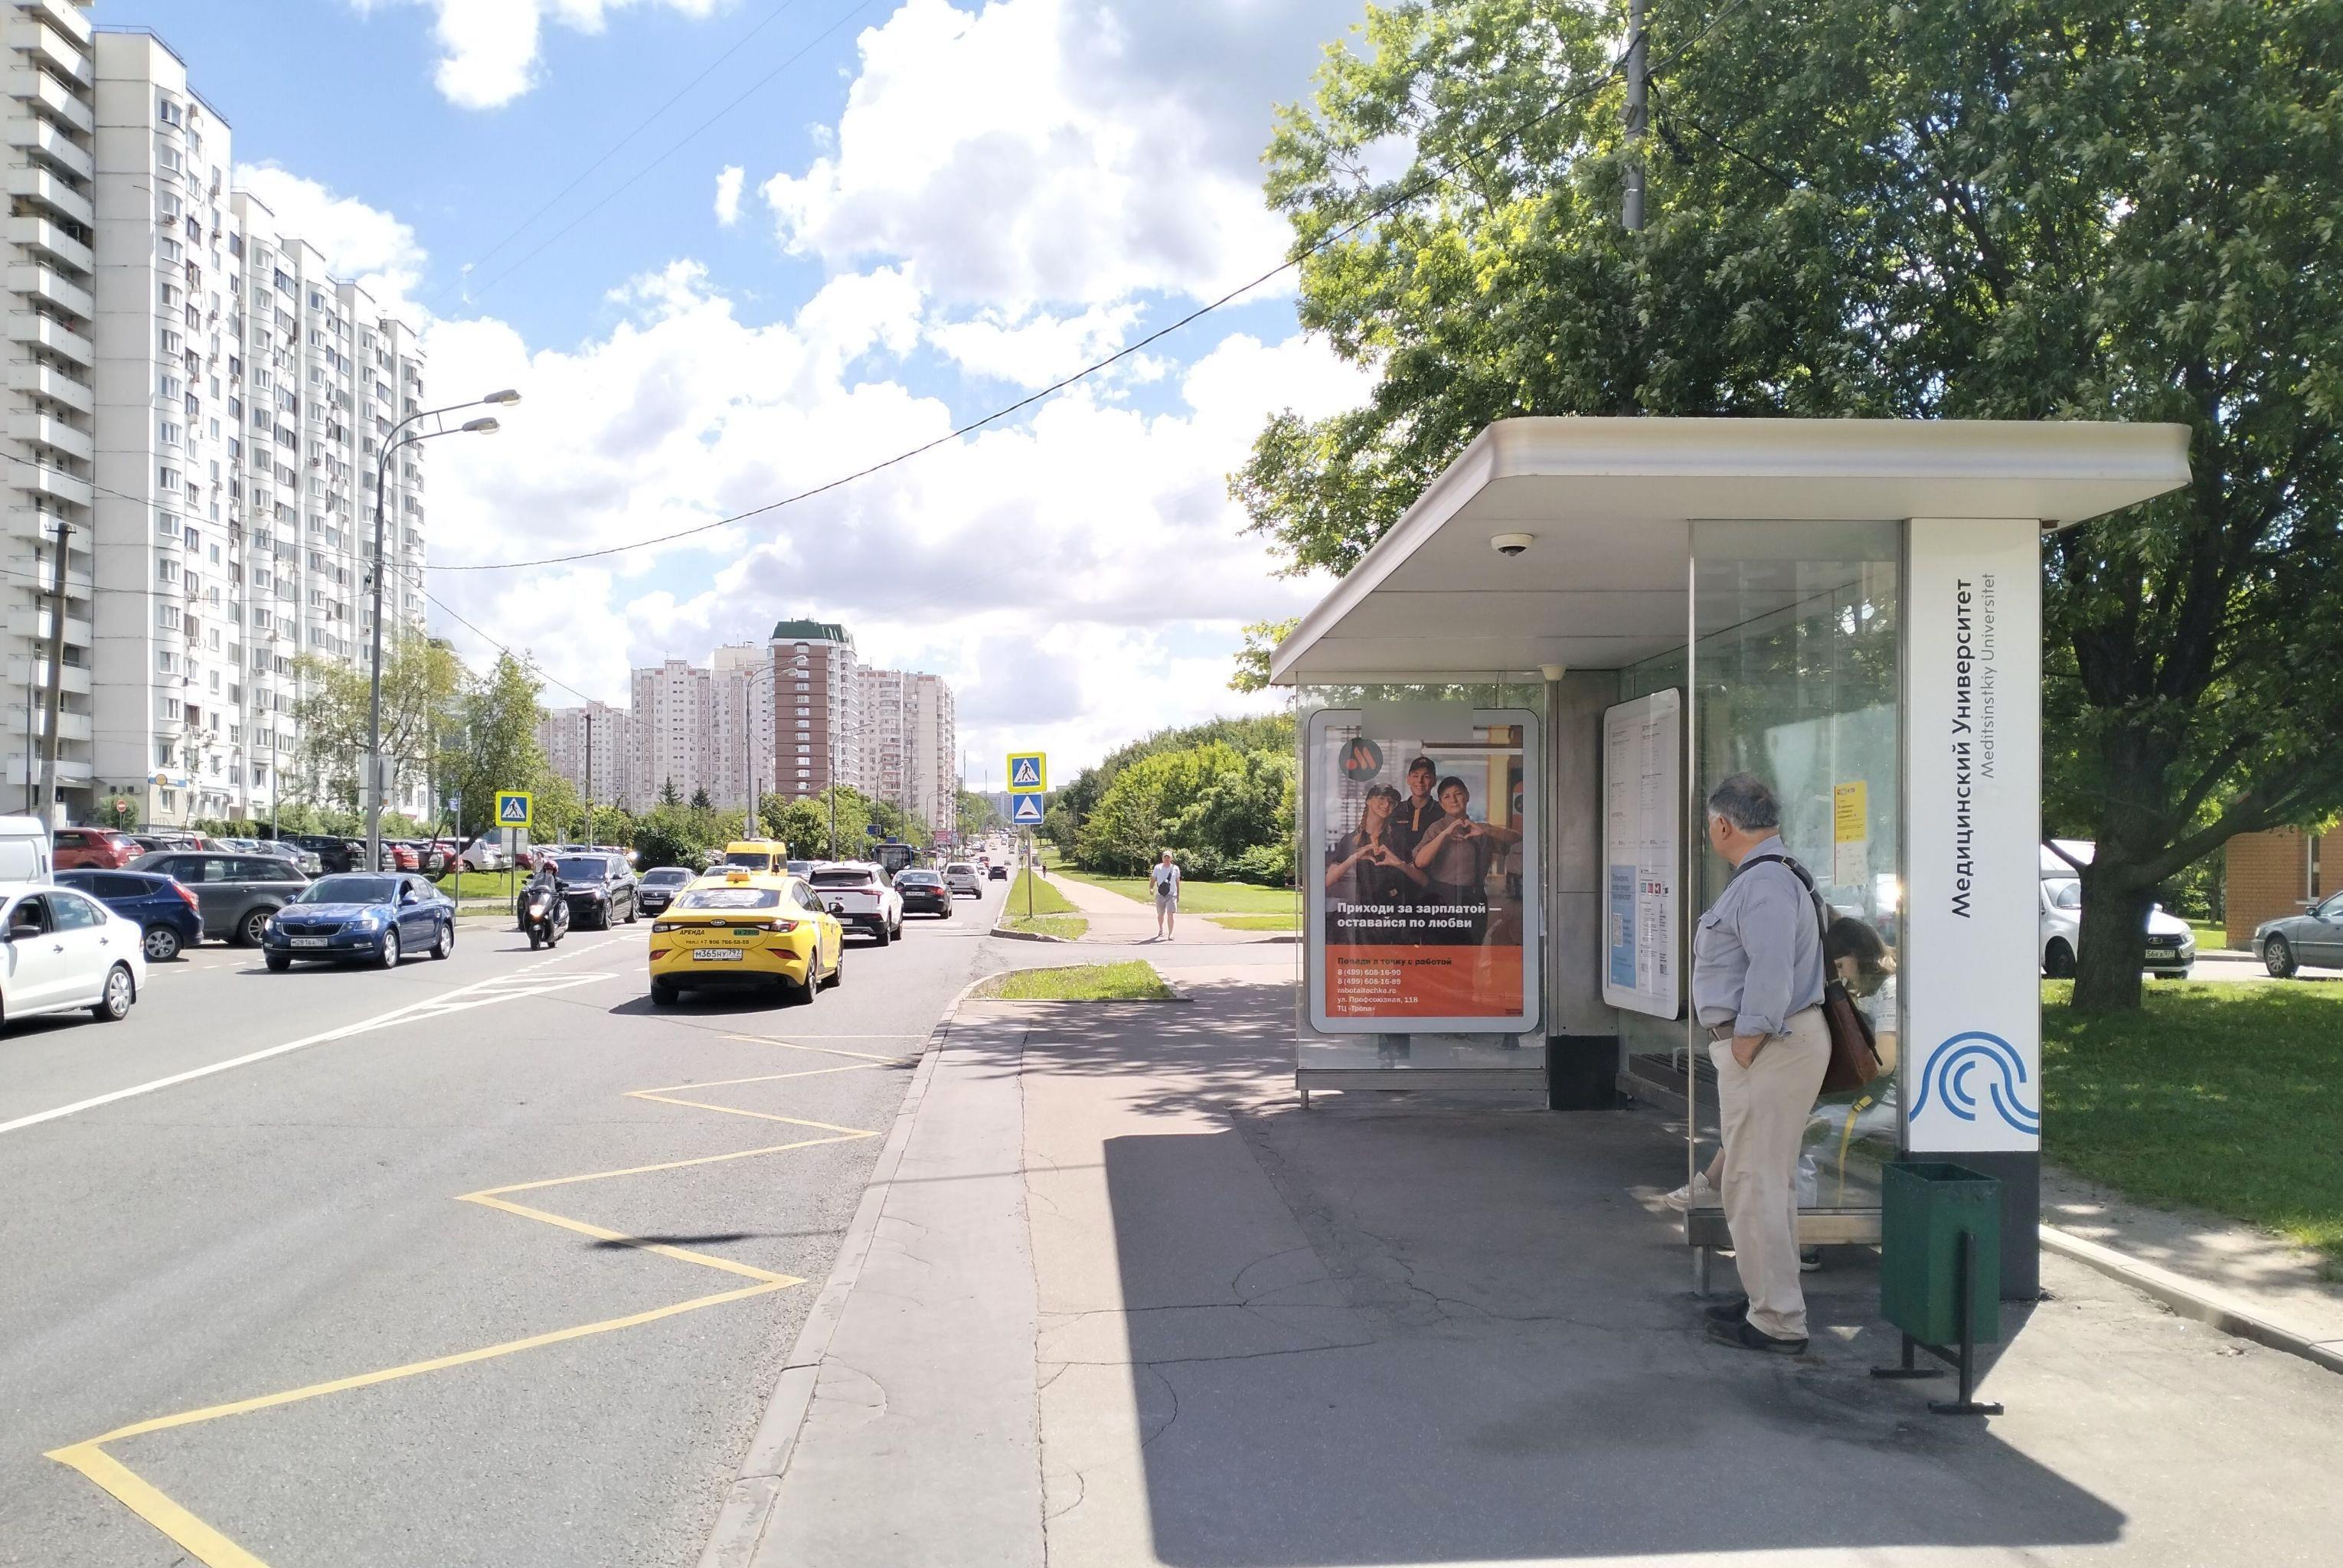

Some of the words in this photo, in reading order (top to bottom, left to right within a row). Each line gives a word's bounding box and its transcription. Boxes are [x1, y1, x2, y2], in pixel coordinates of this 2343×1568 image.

[1981, 573, 1995, 661] Universitet
[1952, 579, 1975, 734] Университет
[1980, 666, 1997, 779] Meditsinstkiy
[1952, 742, 1974, 919] Медицинский
[1337, 902, 1394, 914] Приходи
[1397, 905, 1413, 913] за
[1416, 902, 1486, 915] зарплатой
[1337, 916, 1407, 928] оставайся
[1410, 920, 1426, 928] по
[1428, 917, 1472, 928] любви
[695, 949, 727, 958] М365НУ
[1414, 957, 1452, 966] работой
